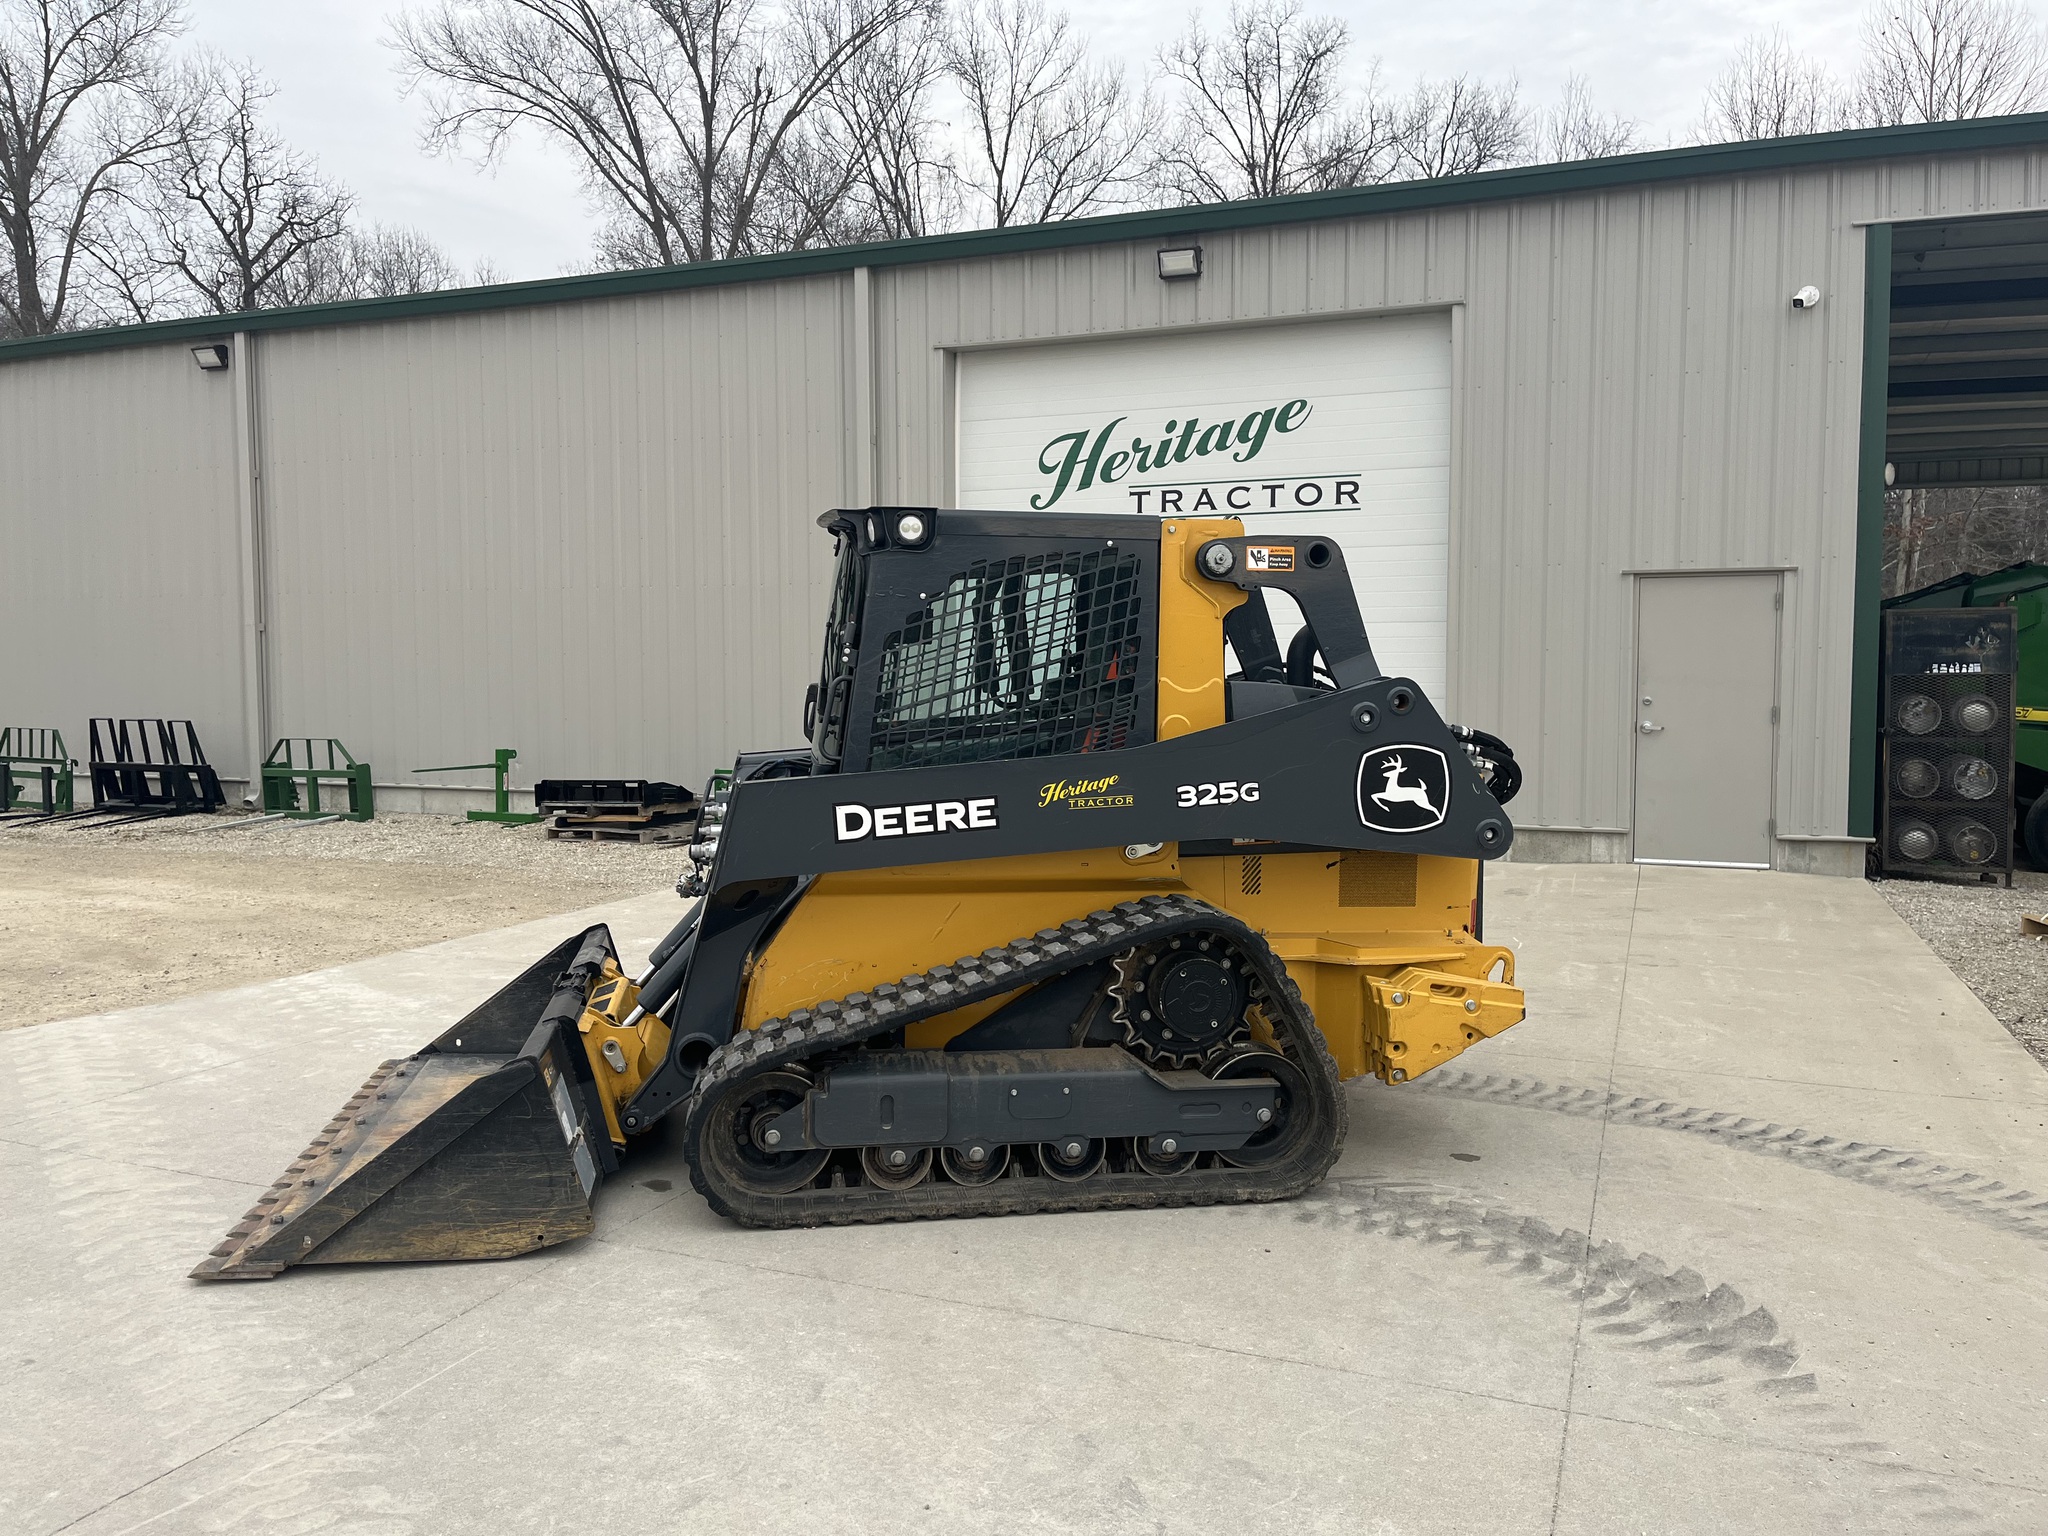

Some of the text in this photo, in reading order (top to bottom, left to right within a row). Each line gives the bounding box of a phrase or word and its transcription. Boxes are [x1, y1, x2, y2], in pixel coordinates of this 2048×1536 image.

[1030, 399, 1313, 510] Heritage
[1129, 481, 1360, 514] TRACTOR
[1038, 775, 1120, 808] Heritage
[1068, 797, 1133, 808] TRACTOR
[1177, 781, 1260, 807] 325G
[835, 798, 997, 841] DEERE
